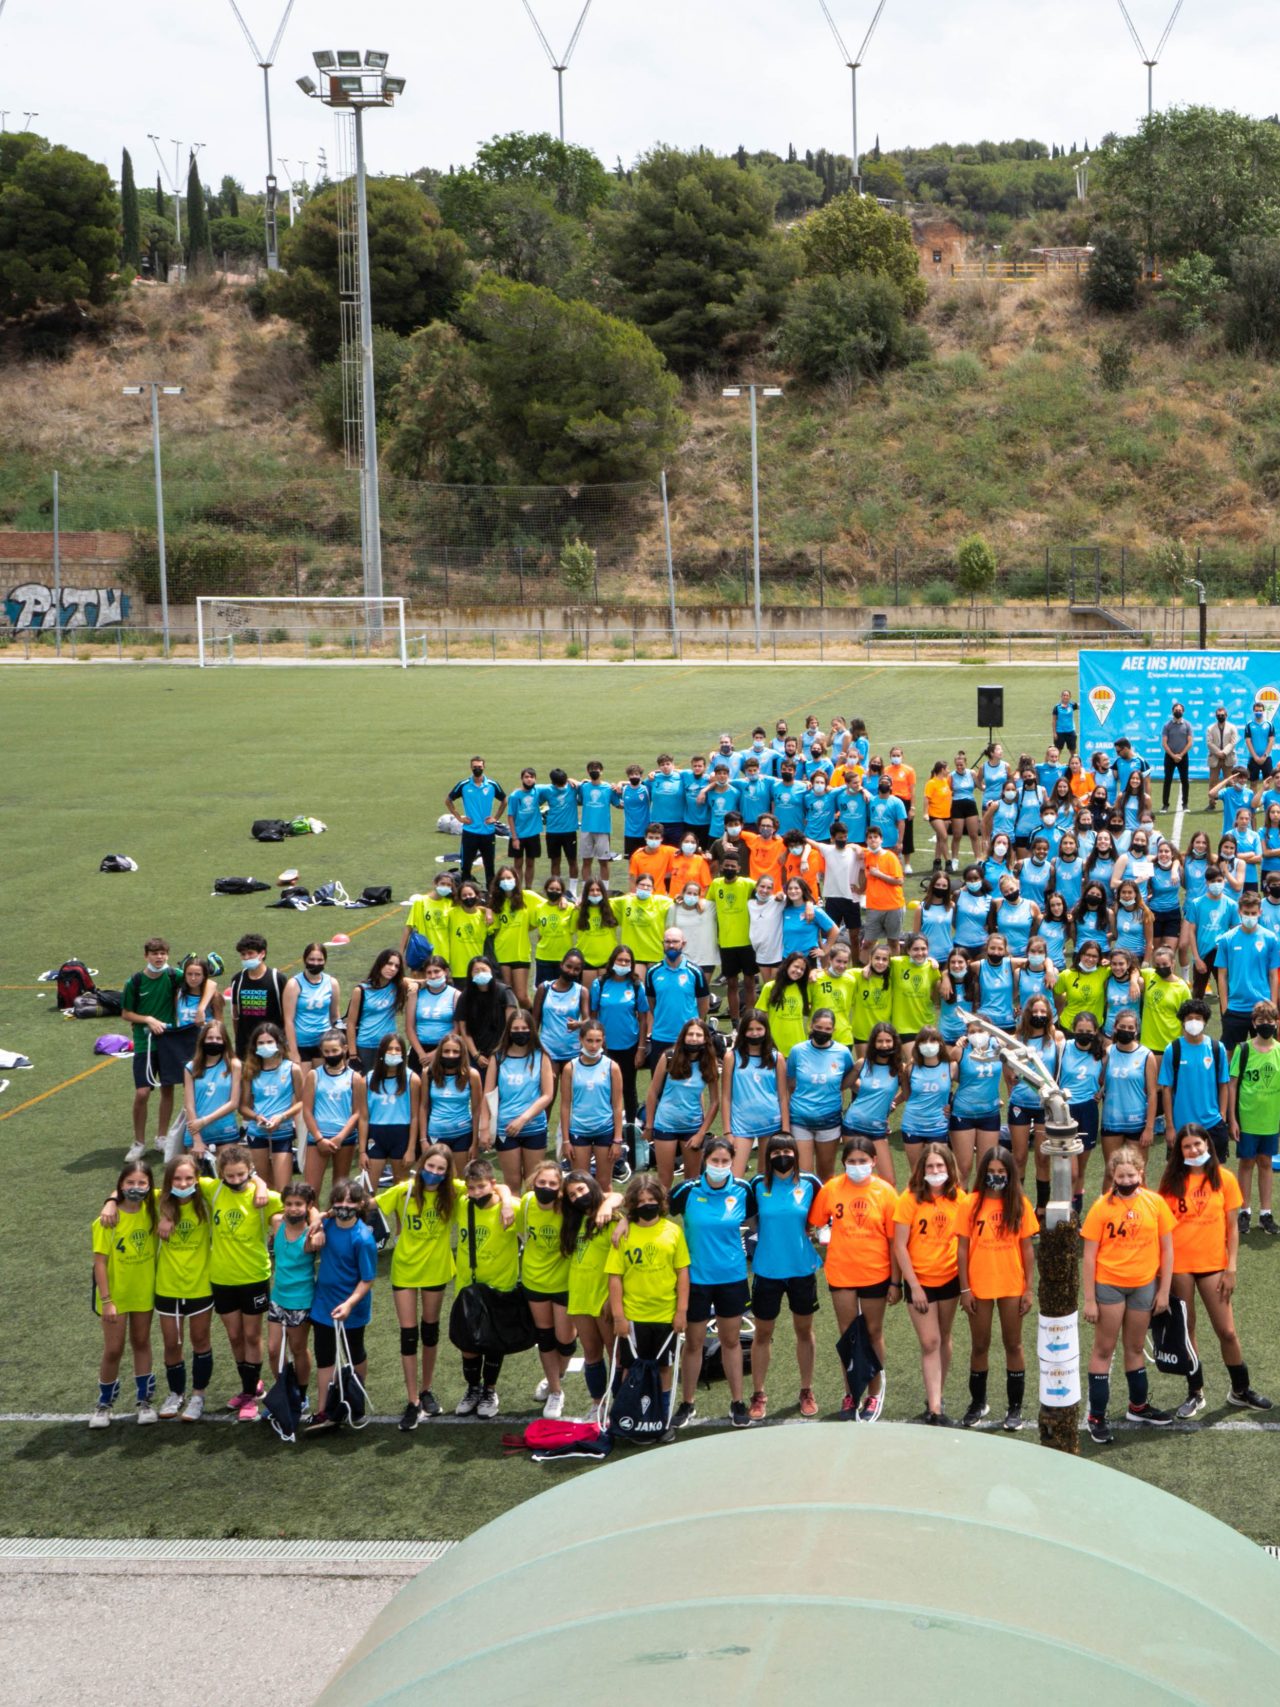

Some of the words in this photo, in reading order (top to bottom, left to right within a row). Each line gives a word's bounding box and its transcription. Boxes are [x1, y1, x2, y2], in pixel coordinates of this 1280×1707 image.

[1121, 656, 1146, 670] AEE
[1147, 656, 1168, 670] INS
[1169, 656, 1249, 670] MONTSERRAT
[718, 889, 724, 899] 8
[425, 911, 431, 921] 6
[626, 907, 631, 916] 3
[456, 928, 461, 937] 4
[904, 969, 910, 980] 6
[821, 982, 832, 994] 15
[1073, 977, 1079, 988] 4
[1149, 980, 1157, 990] 7
[863, 990, 869, 1000] 9
[753, 1072, 760, 1082] 6
[1076, 1066, 1087, 1080] 2
[1247, 1069, 1260, 1082] 13
[206, 1082, 215, 1096] 3
[872, 1078, 880, 1088] 5
[835, 1203, 843, 1219] 3
[214, 1210, 220, 1226] 6
[407, 1215, 422, 1230] 15
[919, 1219, 927, 1235] 2
[977, 1220, 985, 1236] 7
[1107, 1222, 1127, 1239] 24
[461, 1228, 468, 1242] 9
[116, 1238, 126, 1253] 4
[625, 1248, 643, 1264] 12
[1157, 1350, 1178, 1365] JAKO
[634, 1420, 663, 1432] JAKO
